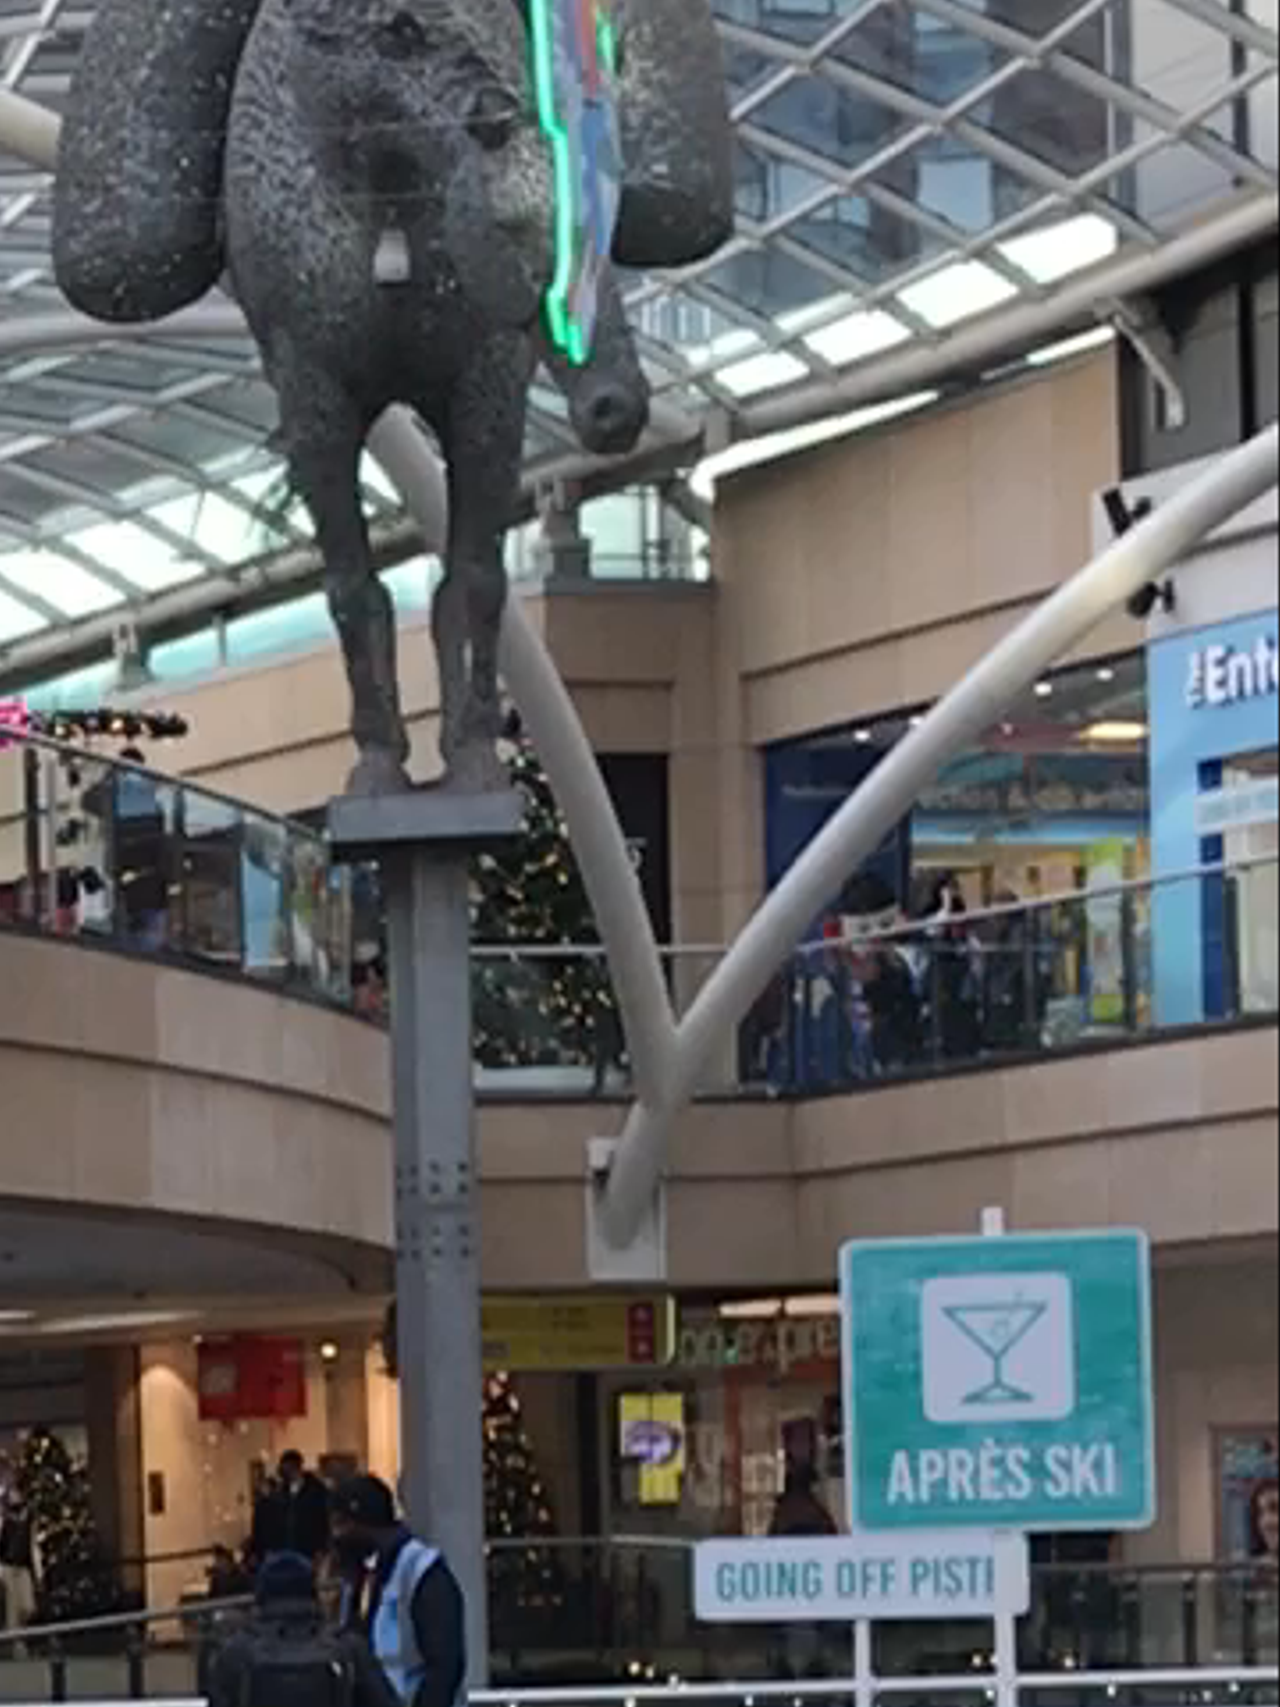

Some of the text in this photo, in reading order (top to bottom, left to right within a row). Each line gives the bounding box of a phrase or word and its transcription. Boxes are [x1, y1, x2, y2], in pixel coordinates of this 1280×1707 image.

[886, 1438, 1117, 1505] APRÈS SKI
[715, 1560, 823, 1603] GOING
[836, 1557, 897, 1600] OFF
